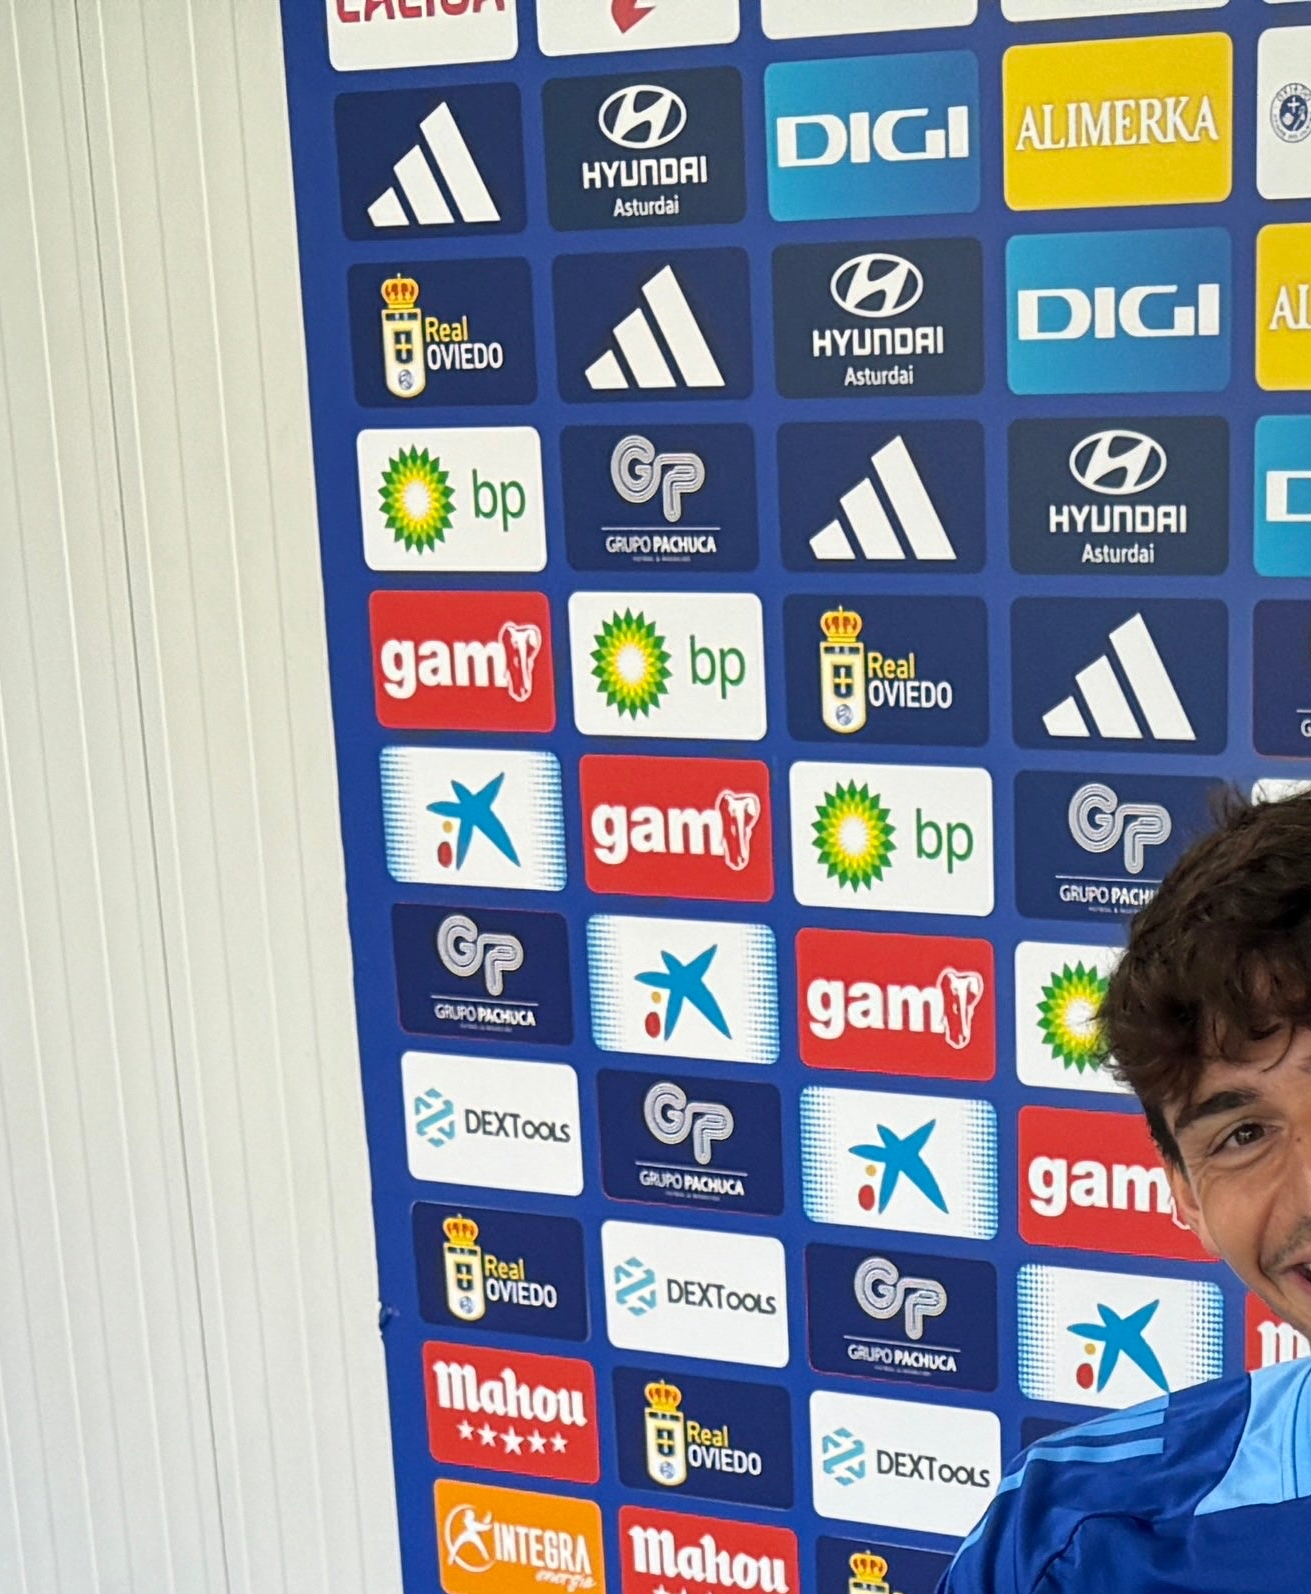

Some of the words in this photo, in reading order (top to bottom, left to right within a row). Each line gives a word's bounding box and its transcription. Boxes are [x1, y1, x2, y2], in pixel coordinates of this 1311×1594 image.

[776, 105, 969, 168] DIGI
[1015, 95, 1219, 152] ALIMERKA
[583, 155, 707, 188] HYUNDAI
[613, 194, 679, 217] Asturdai
[1017, 284, 1219, 340] DIGI
[425, 316, 467, 343] Real
[812, 326, 943, 356] HYUNDAI
[427, 341, 503, 371] OVIEDO
[844, 365, 914, 387] Asturdai
[472, 469, 526, 532] bp
[1049, 505, 1186, 533] HYUNDAI
[653, 535, 716, 553] PACHUCA
[1081, 543, 1155, 564] Asturdai
[381, 637, 506, 700] gam
[690, 636, 745, 698] bp
[867, 652, 916, 680] Real
[867, 678, 952, 709] OVIEDO
[591, 803, 722, 865] gam
[916, 809, 973, 873] bp
[1059, 884, 1108, 905] GRUPO
[1111, 885, 1153, 906] PACH
[807, 977, 942, 1041] gam
[484, 1256, 525, 1281] Real
[486, 1278, 557, 1308] OVIEDO
[433, 1360, 587, 1427] Mahou
[687, 1421, 729, 1448] Real
[689, 1445, 761, 1476] OVIEDO
[493, 1522, 590, 1574] INTEGRA
[629, 1526, 789, 1594] Mahou
